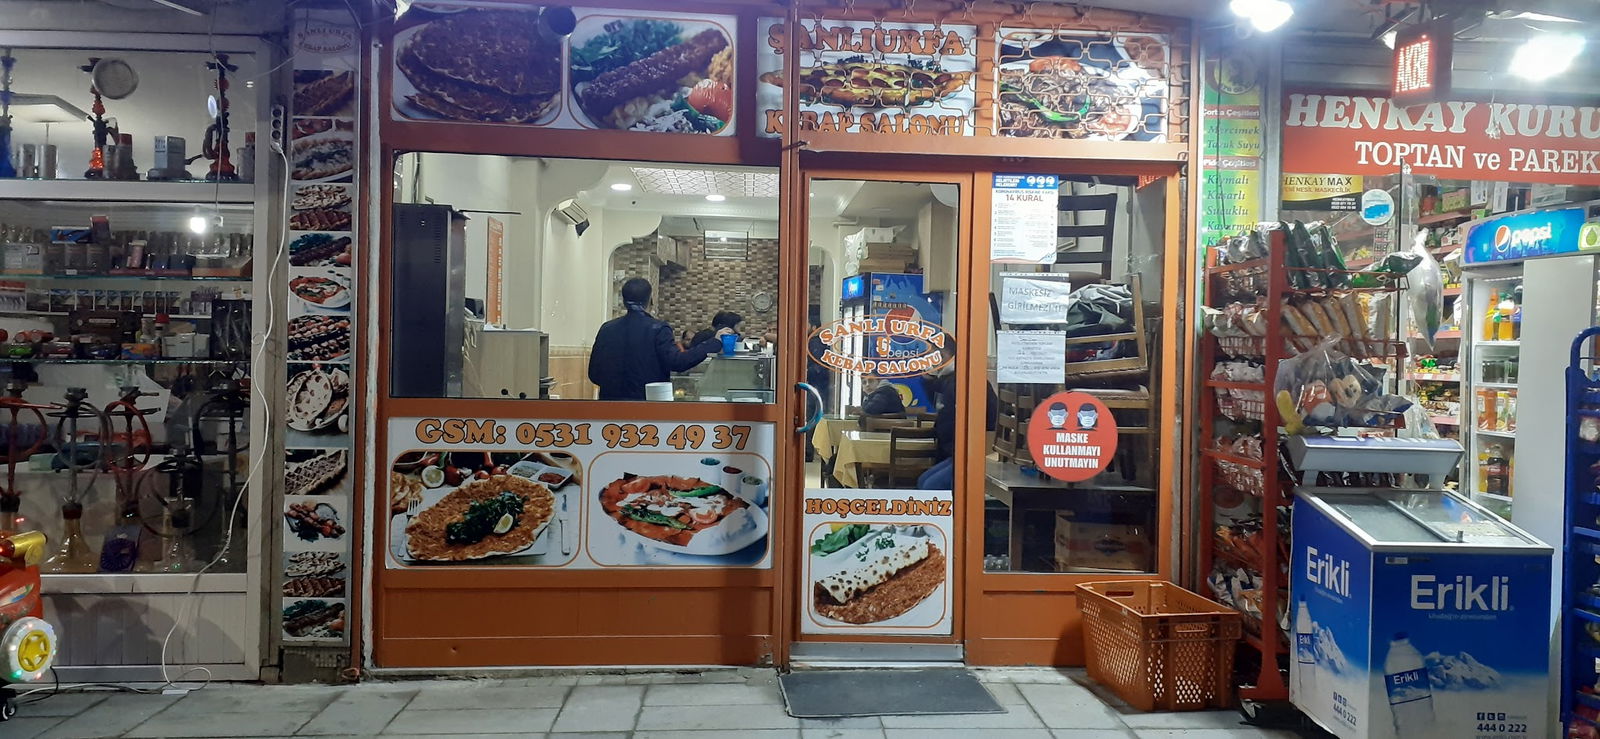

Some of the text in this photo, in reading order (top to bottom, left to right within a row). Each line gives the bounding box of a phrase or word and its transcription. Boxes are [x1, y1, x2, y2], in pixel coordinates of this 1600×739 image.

[765, 109, 965, 136] KBAP SALONU
[1286, 94, 1476, 134] HENKAY
[1237, 141, 1260, 152] Suyu
[1355, 141, 1600, 174] TOPTAN ve PAREK
[1327, 177, 1352, 186] MAX
[1006, 194, 1044, 202] 14 KURAL
[1511, 222, 1552, 247] pepsi
[889, 319, 946, 349] URFA
[820, 350, 942, 375] KEBAP SALONU
[888, 347, 919, 359] pepsi
[415, 418, 752, 450] GSM: 0531 932 49 37
[1056, 432, 1089, 444] MASKE
[1043, 444, 1101, 457] KULLANMAYI
[1044, 457, 1099, 469] UNUTMAYIN
[805, 496, 953, 519] HOŞGELDİNİZ
[1306, 545, 1350, 598] Erikli
[1411, 574, 1509, 611] Erikli
[1393, 671, 1419, 685] Erikli
[1477, 723, 1527, 733] 444 0 222
